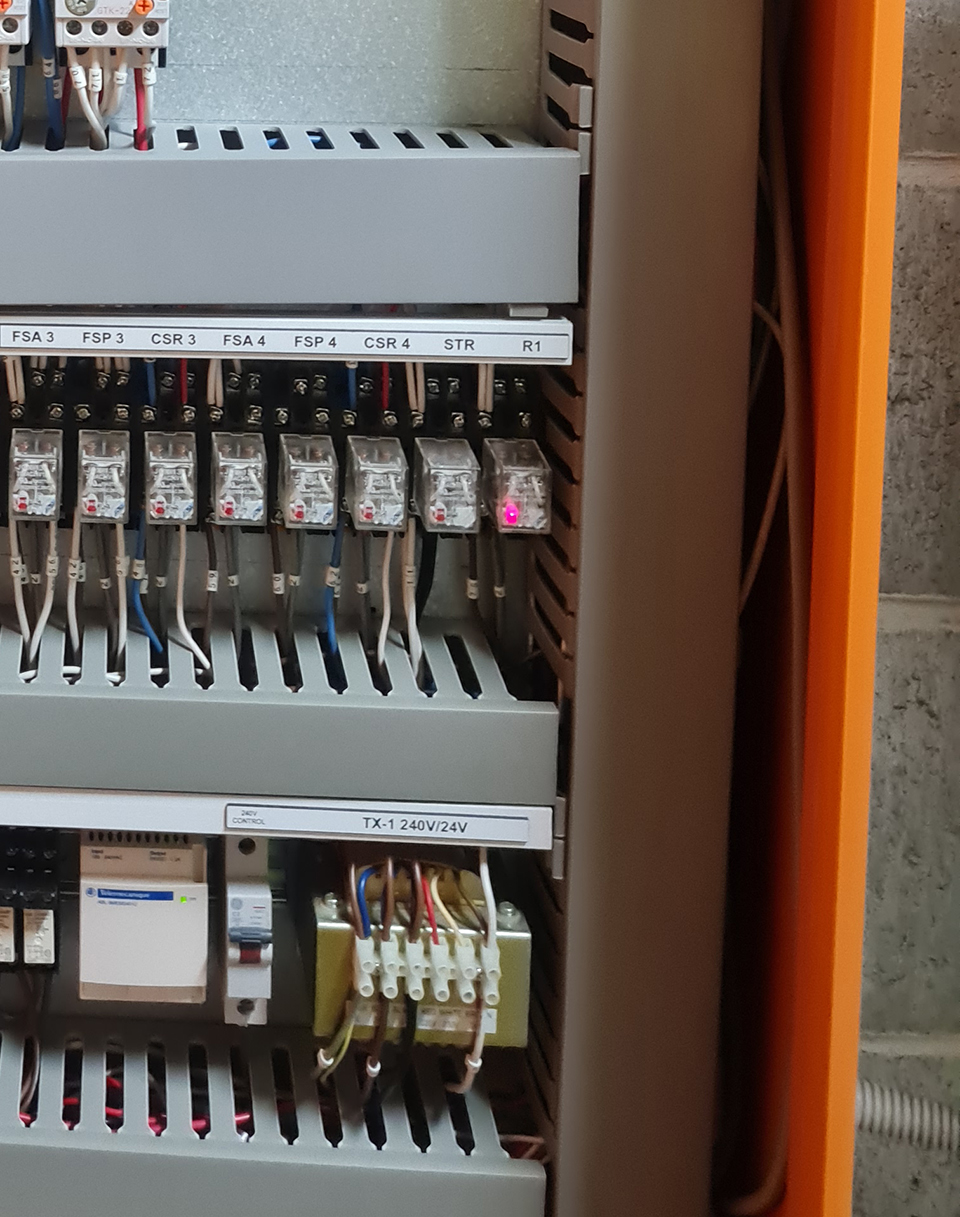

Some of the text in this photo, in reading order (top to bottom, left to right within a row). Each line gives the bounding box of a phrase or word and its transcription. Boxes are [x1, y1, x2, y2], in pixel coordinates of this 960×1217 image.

[73, 69, 81, 86] 70
[143, 66, 152, 81] 72
[12, 331, 54, 343] FSA 3
[82, 332, 124, 344] FSP 3
[151, 333, 196, 345] CSR 3
[223, 334, 266, 346] FSA 4
[294, 336, 337, 348] FSP 4
[364, 337, 411, 349] CSR 4
[444, 338, 476, 350] STR
[522, 340, 541, 352] R1
[363, 817, 468, 833] TX-1 240V/24V
